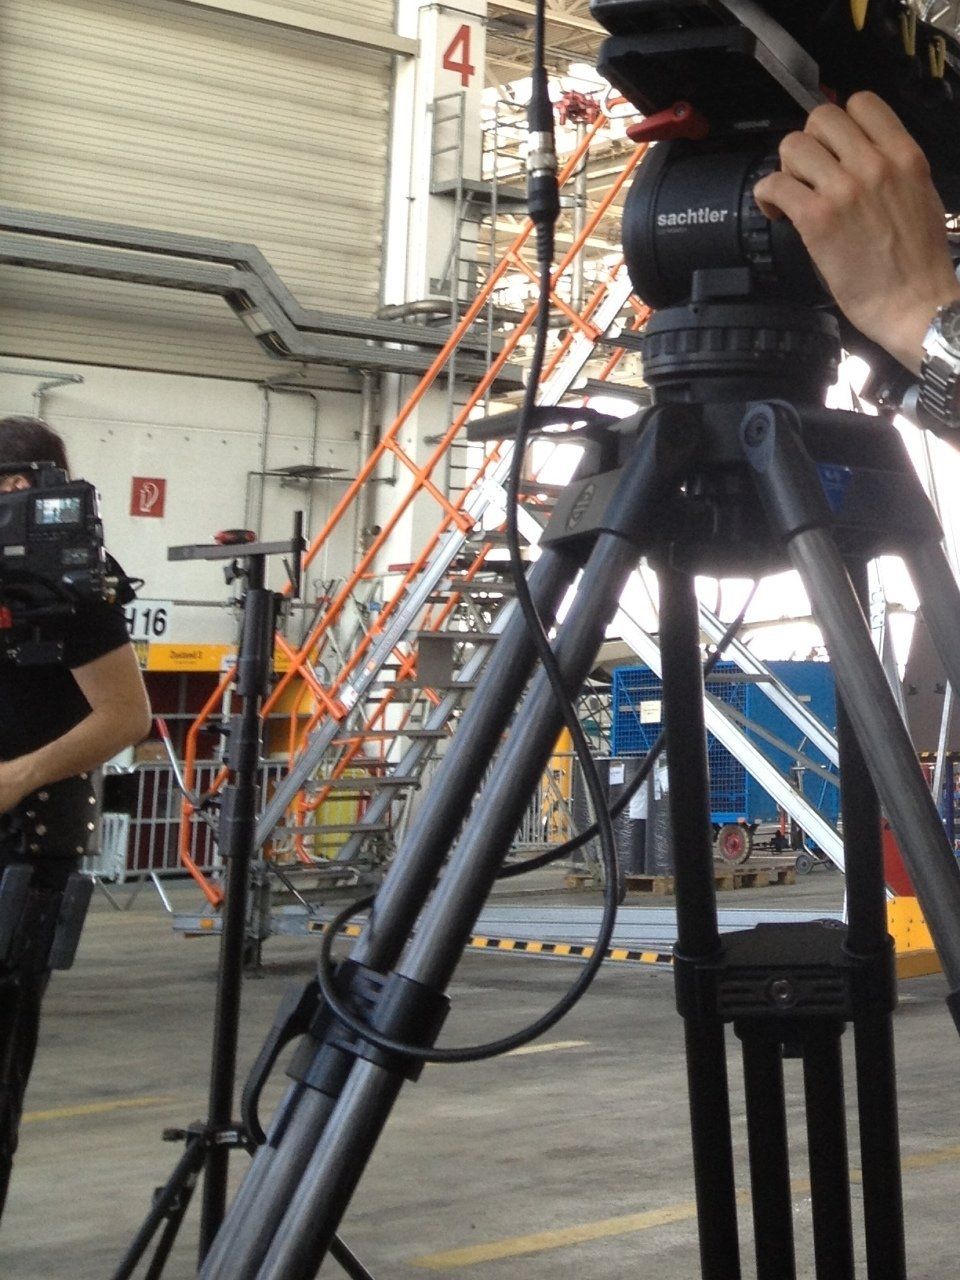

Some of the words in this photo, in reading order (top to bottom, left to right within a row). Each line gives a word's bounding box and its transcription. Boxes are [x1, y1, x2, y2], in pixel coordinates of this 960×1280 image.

[443, 24, 475, 87] 4
[657, 207, 728, 226] sachtler
[142, 607, 168, 637] 16
